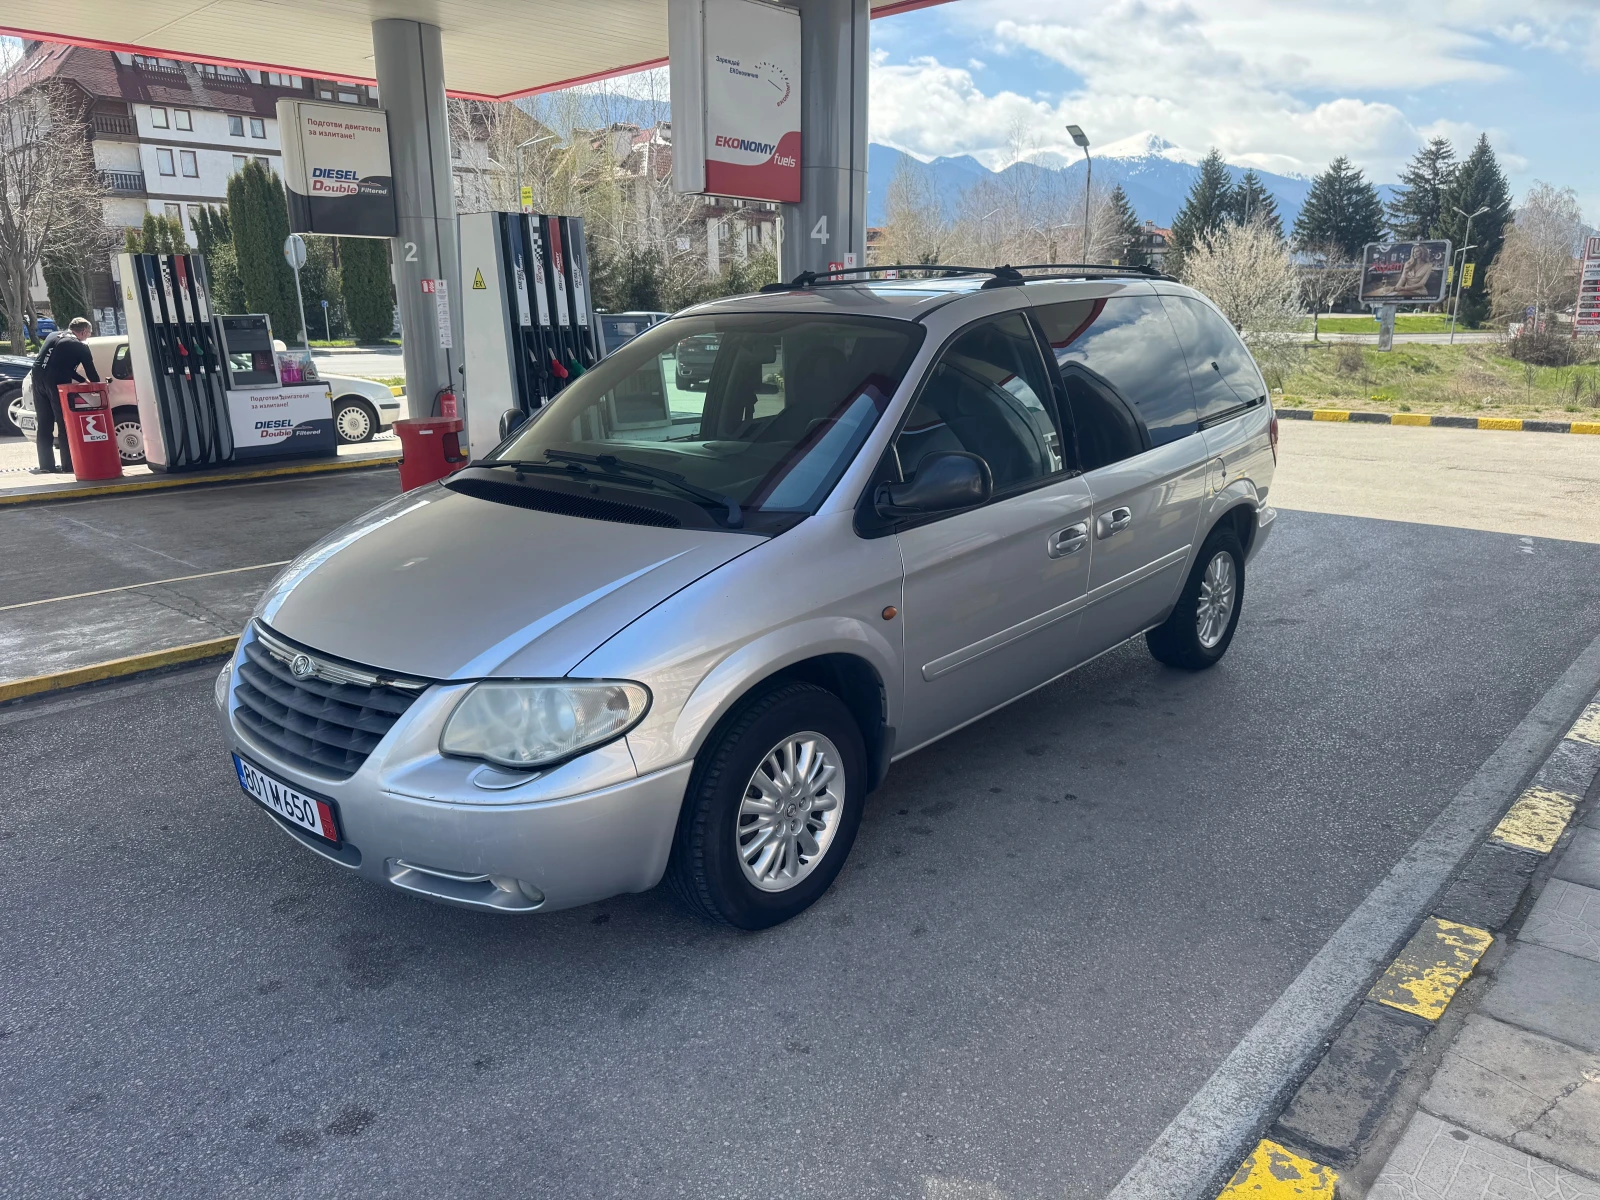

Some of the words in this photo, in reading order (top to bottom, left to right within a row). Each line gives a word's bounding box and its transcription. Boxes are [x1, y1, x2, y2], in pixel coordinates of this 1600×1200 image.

[307, 118, 343, 128] Подготви
[345, 123, 381, 133] двигателя
[318, 130, 356, 140] излитане!
[715, 135, 776, 155] EKONOMY
[773, 153, 796, 168] fuels
[312, 167, 359, 181] DIESEL
[312, 180, 357, 194] Double
[360, 187, 387, 195] Filtered
[810, 215, 830, 245] 4
[404, 242, 418, 262] 2
[475, 280, 483, 288] EX
[254, 419, 293, 430] DIESEL
[260, 429, 292, 438] Double
[296, 429, 321, 437] Filtered
